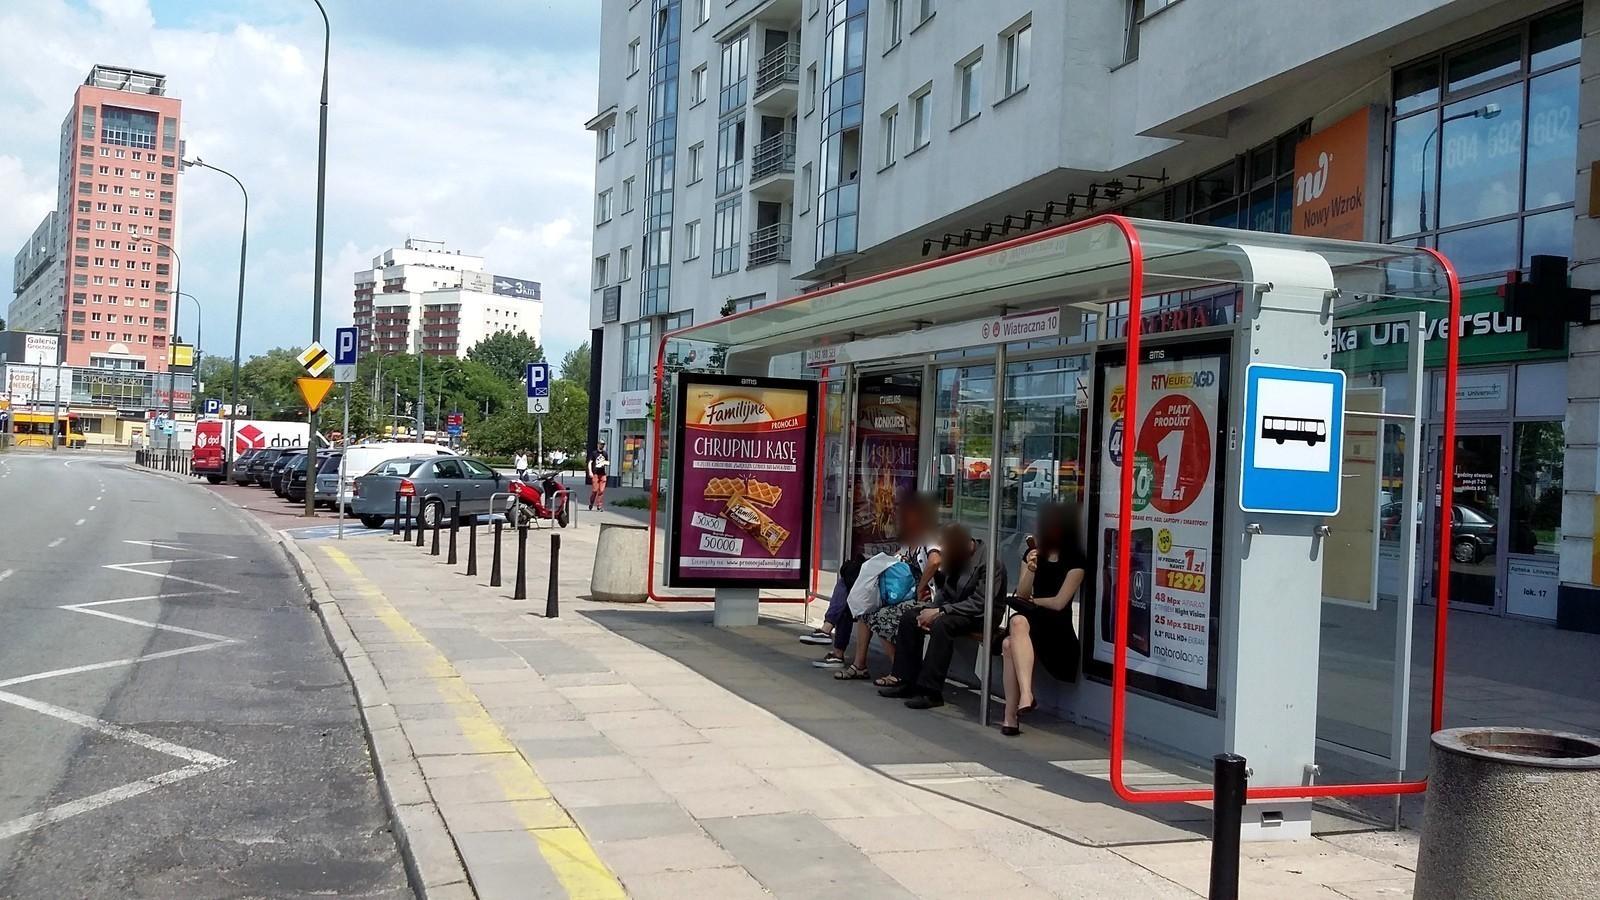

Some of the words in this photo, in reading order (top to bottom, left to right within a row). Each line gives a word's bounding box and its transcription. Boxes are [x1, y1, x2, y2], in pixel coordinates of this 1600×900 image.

[1533, 104, 1571, 145] 602
[1303, 207, 1329, 229] Nowy
[1331, 186, 1362, 218] Wzrok
[1003, 320, 1046, 337] Wiatraczna
[1048, 316, 1058, 330] 10
[1331, 327, 1358, 353] eka
[1370, 311, 1523, 347] Unversu
[27, 336, 57, 345] Galeria
[340, 331, 353, 361] P
[1149, 350, 1165, 360] ams
[532, 366, 545, 388] P
[1152, 374, 1168, 391] RTV
[1193, 370, 1215, 388] AGD
[706, 400, 766, 425] Familijne
[1168, 404, 1192, 417] PIĄTY
[771, 418, 799, 430] PROMOCJA
[874, 416, 905, 429] KONKURS
[1153, 416, 1190, 427] PRODUKT
[208, 435, 220, 446] dpd
[270, 433, 301, 447] dpd
[694, 437, 761, 459] CHRUPNIJ
[766, 441, 797, 464] KASĘ
[1156, 430, 1185, 500] 1
[697, 515, 720, 529] 50x50
[703, 536, 736, 552] 50000
[1184, 549, 1195, 571] 1
[1194, 561, 1205, 573] zł
[1167, 571, 1205, 592] 1299
[1155, 592, 1166, 603] 48
[1167, 596, 1181, 606] Mpx
[1538, 589, 1548, 598] 17
[1175, 607, 1188, 616] Night
[1189, 610, 1206, 618] Vision
[1155, 614, 1166, 625] 25
[1167, 619, 1182, 629] Mpx
[1182, 622, 1206, 633] SELFIE
[1165, 631, 1176, 641] FULL
[1177, 633, 1187, 643] HD+
